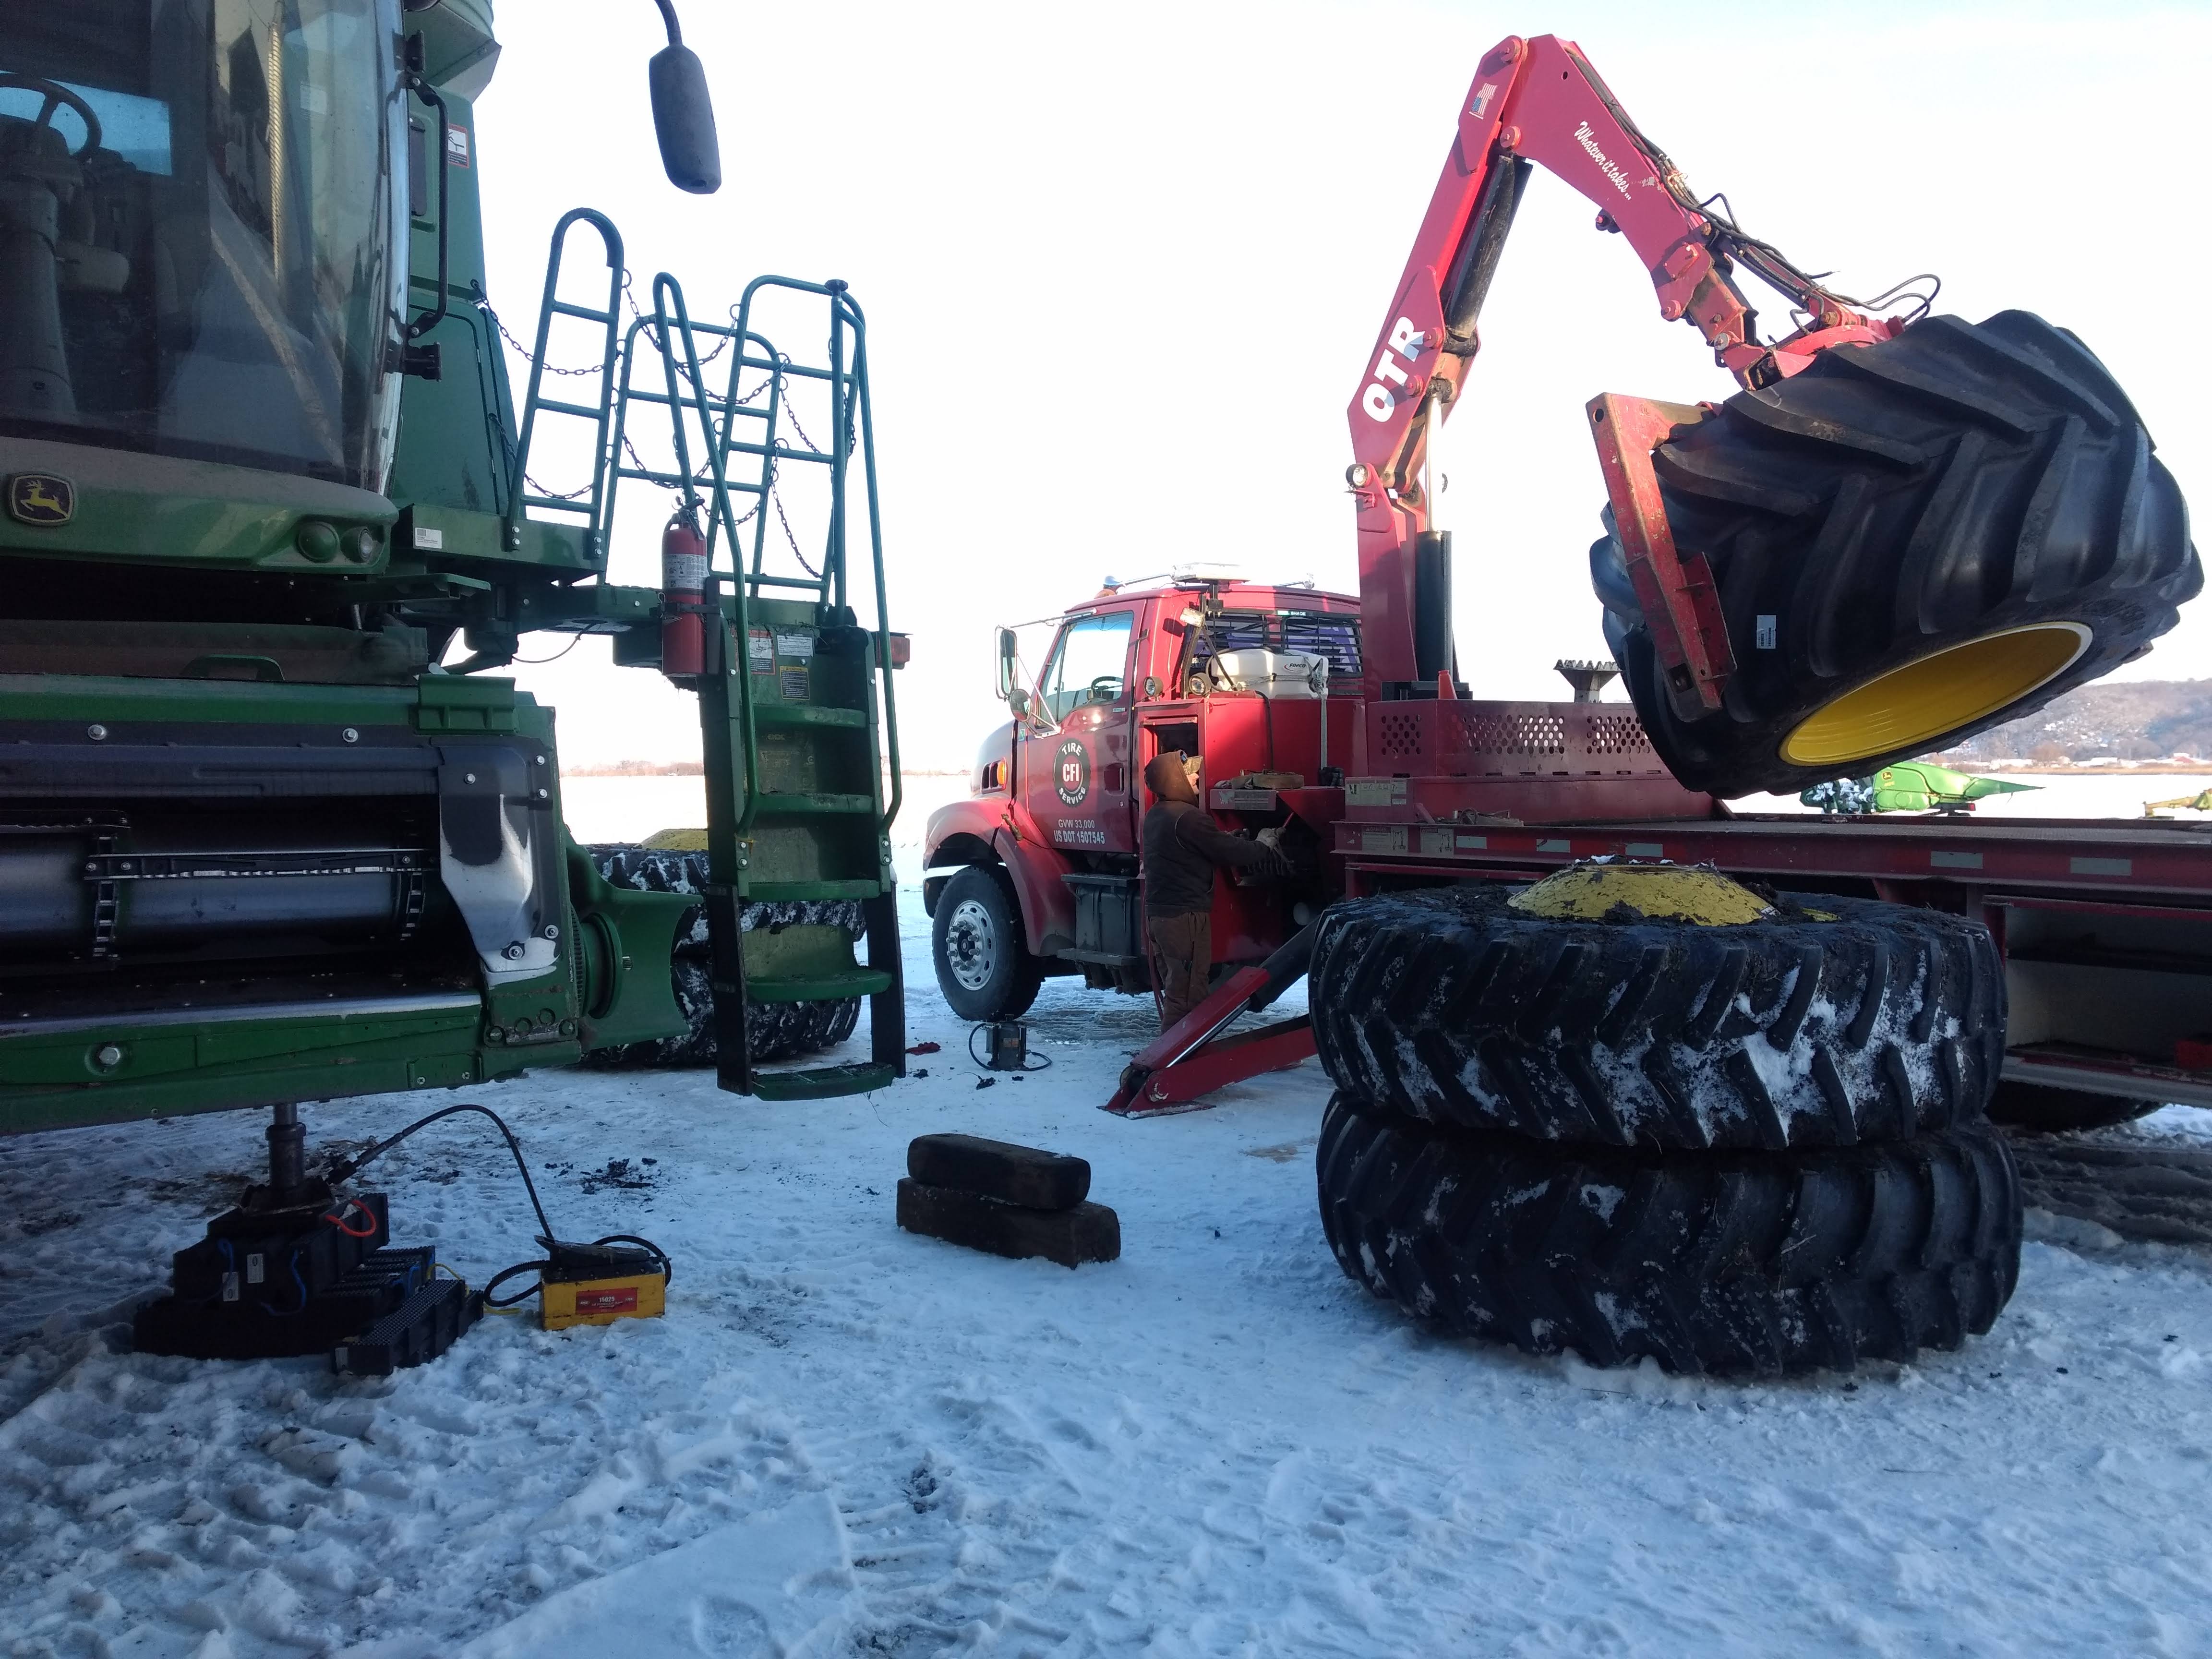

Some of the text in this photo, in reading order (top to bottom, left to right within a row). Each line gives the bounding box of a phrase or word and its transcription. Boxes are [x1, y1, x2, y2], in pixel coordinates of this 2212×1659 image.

[1574, 120, 1606, 166] Whatever
[1602, 159, 1615, 172] it
[1362, 316, 1425, 422] OTR
[1061, 742, 1082, 757] TIRE
[1063, 763, 1079, 782] CFI
[1059, 786, 1086, 805] SERVICE
[1058, 819, 1095, 830] GVW 33,000
[1053, 830, 1105, 844] US DOT 1507545
